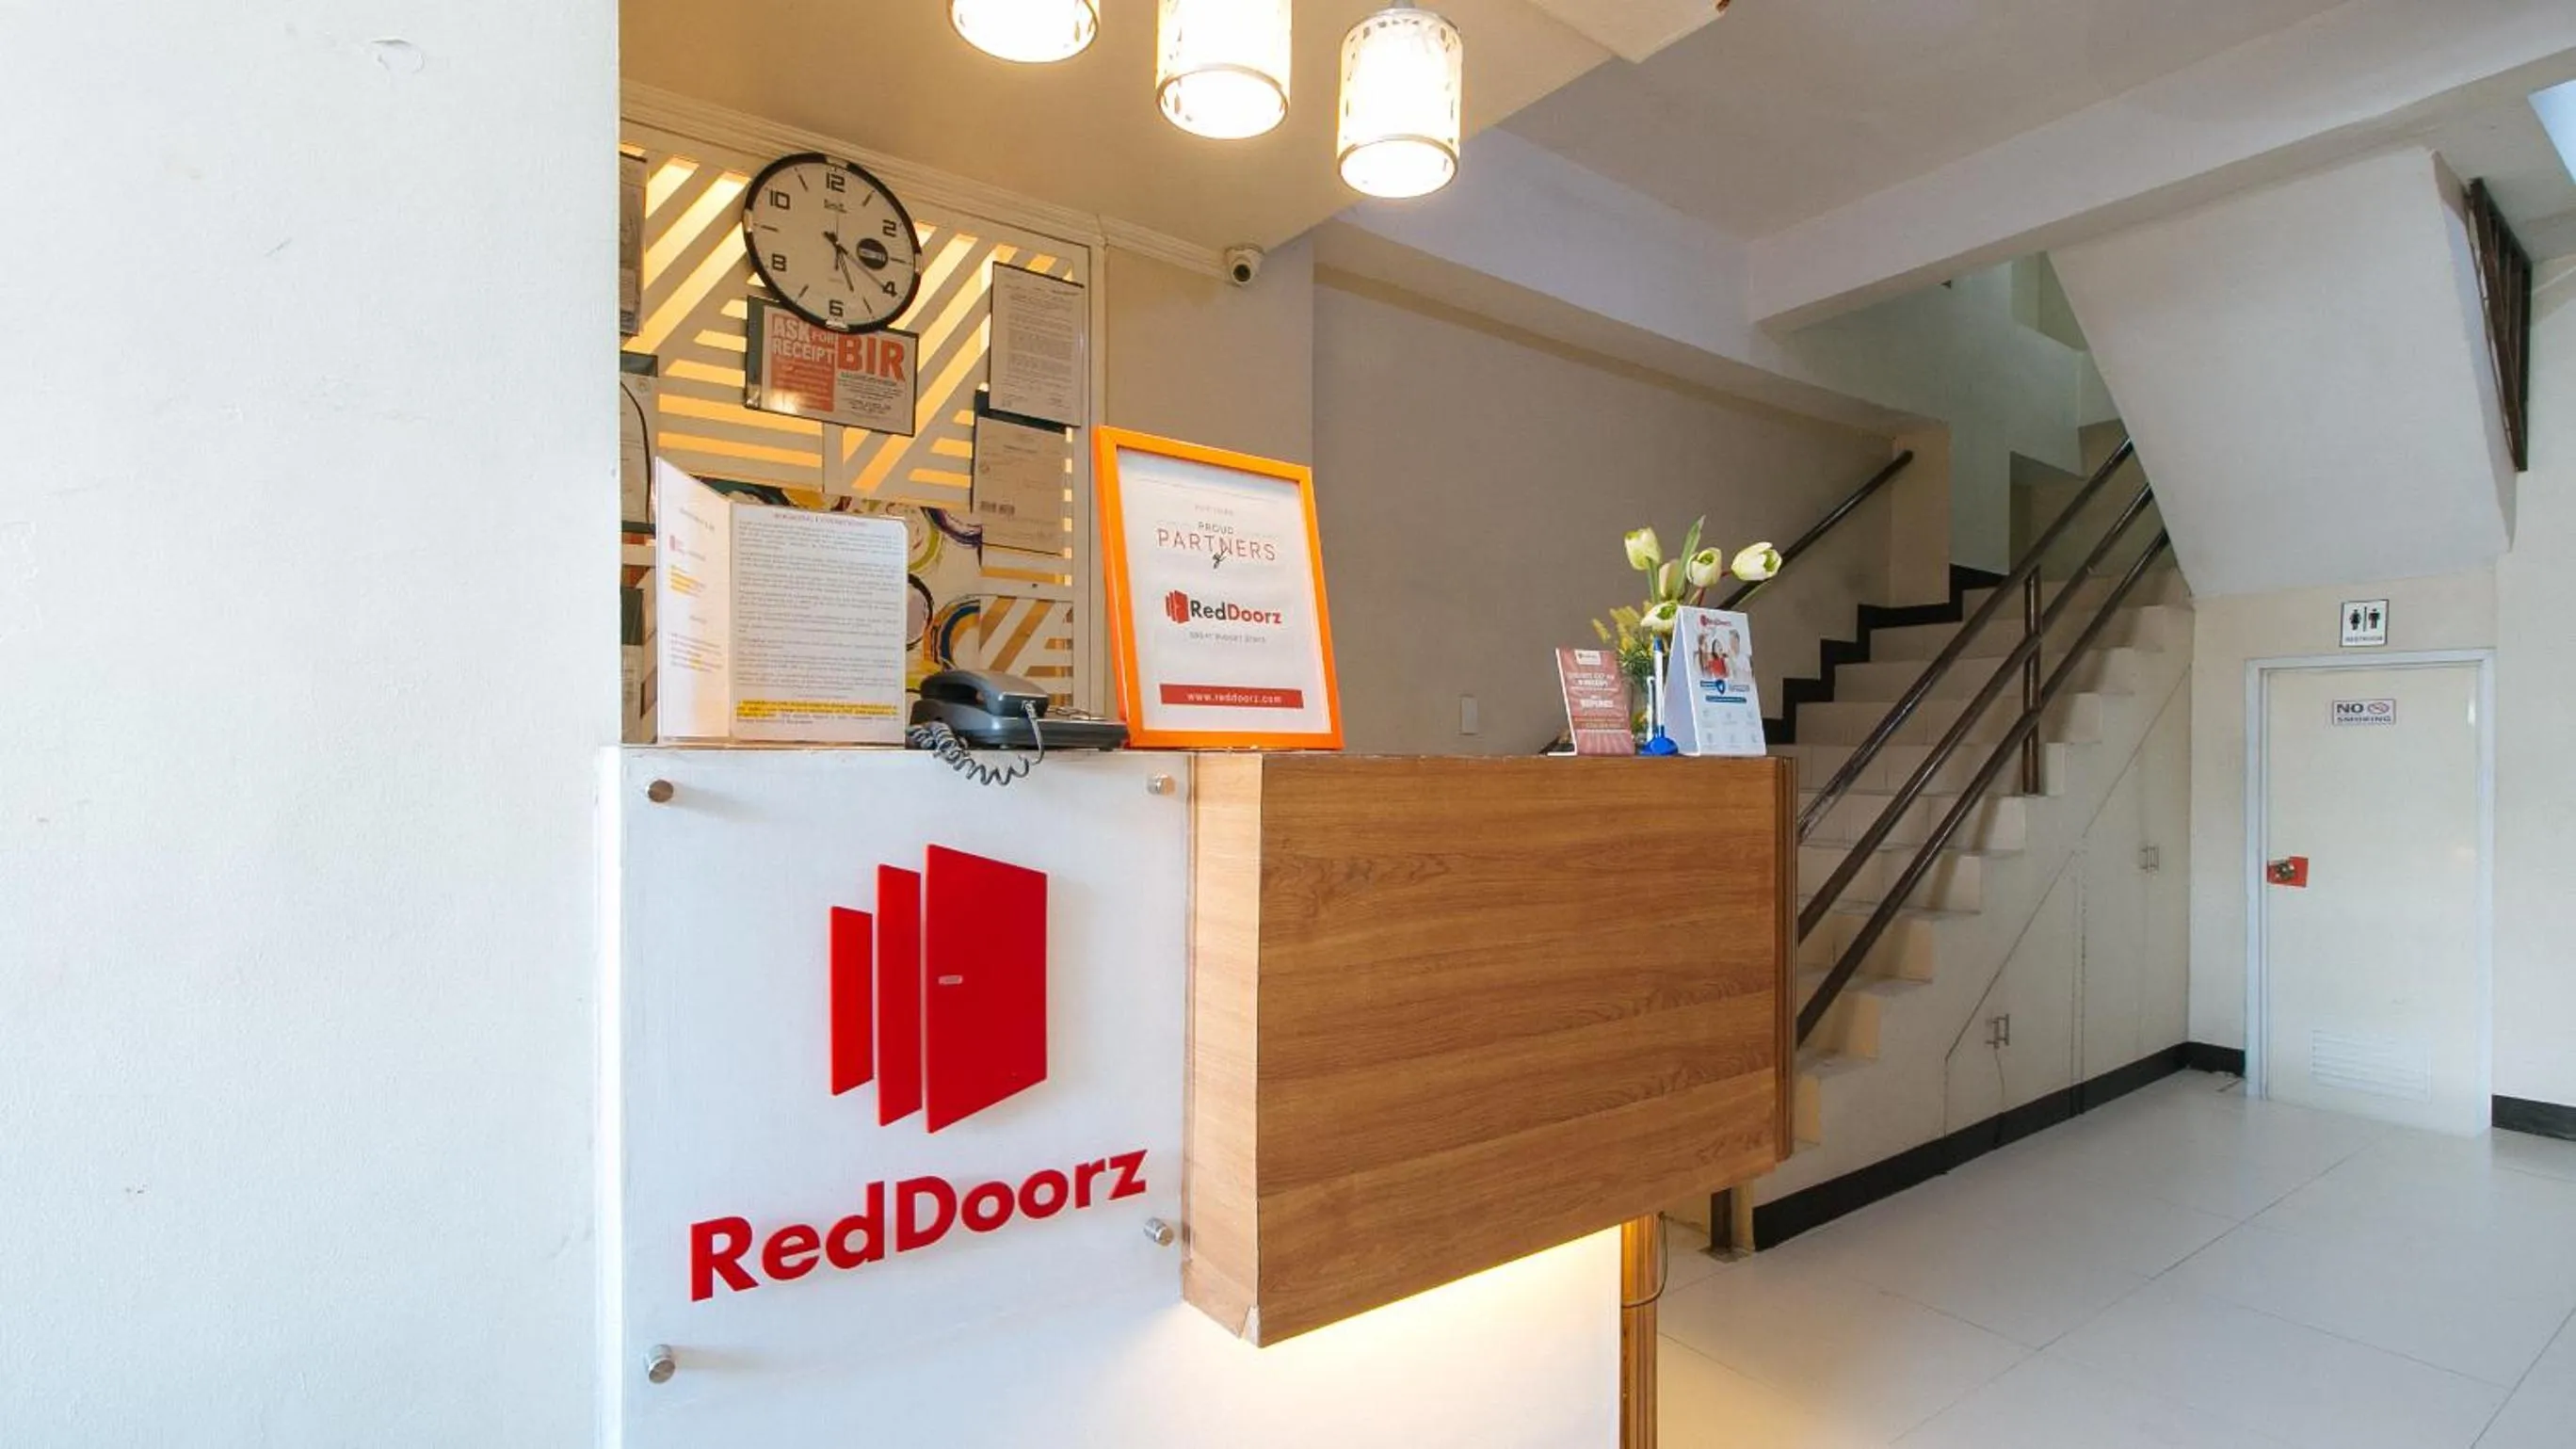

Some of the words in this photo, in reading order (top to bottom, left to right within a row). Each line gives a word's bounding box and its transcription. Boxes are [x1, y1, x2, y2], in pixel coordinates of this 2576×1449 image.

[826, 172, 845, 193] 12
[769, 190, 791, 210] 10
[882, 219, 897, 237] 2
[771, 253, 787, 272] 8
[882, 281, 898, 298] 4
[829, 299, 845, 317] 6
[774, 316, 811, 343] ASK
[774, 338, 837, 364] RECEIPT
[838, 333, 906, 382] BIR
[1198, 521, 1234, 535] PROUD
[1157, 527, 1276, 561] PARTNERS
[1190, 600, 1282, 624] RedDoorz
[1186, 692, 1282, 703] www.reddoorz.com
[2336, 703, 2364, 714] NO
[689, 1149, 1149, 1303] RedDoorz
